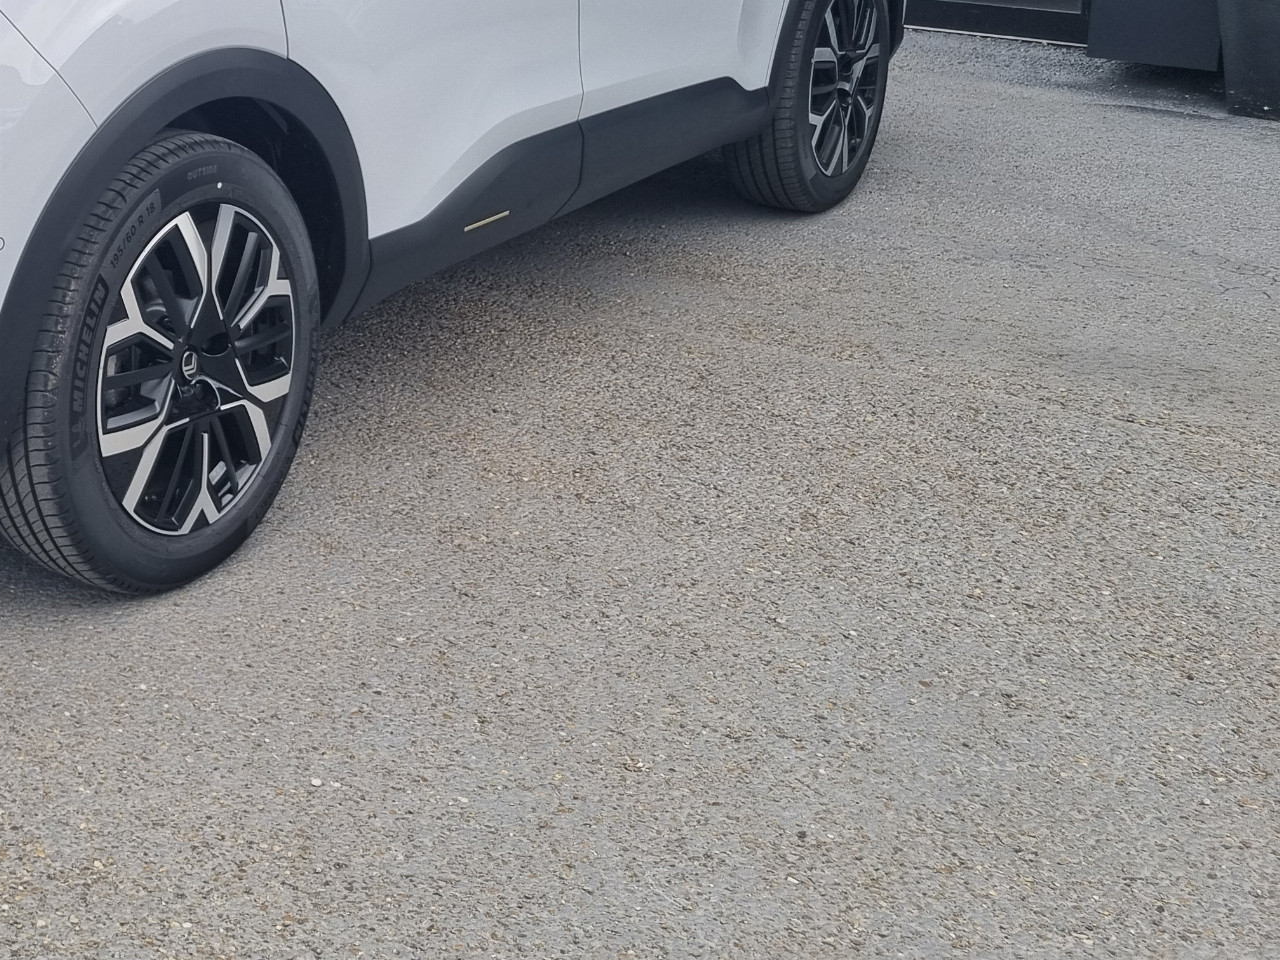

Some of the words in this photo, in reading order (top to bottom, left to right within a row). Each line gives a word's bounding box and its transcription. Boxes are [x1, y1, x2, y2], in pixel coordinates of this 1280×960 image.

[110, 225, 137, 269] 195/60
[138, 214, 145, 227] R
[72, 281, 107, 413] MICHELIN
